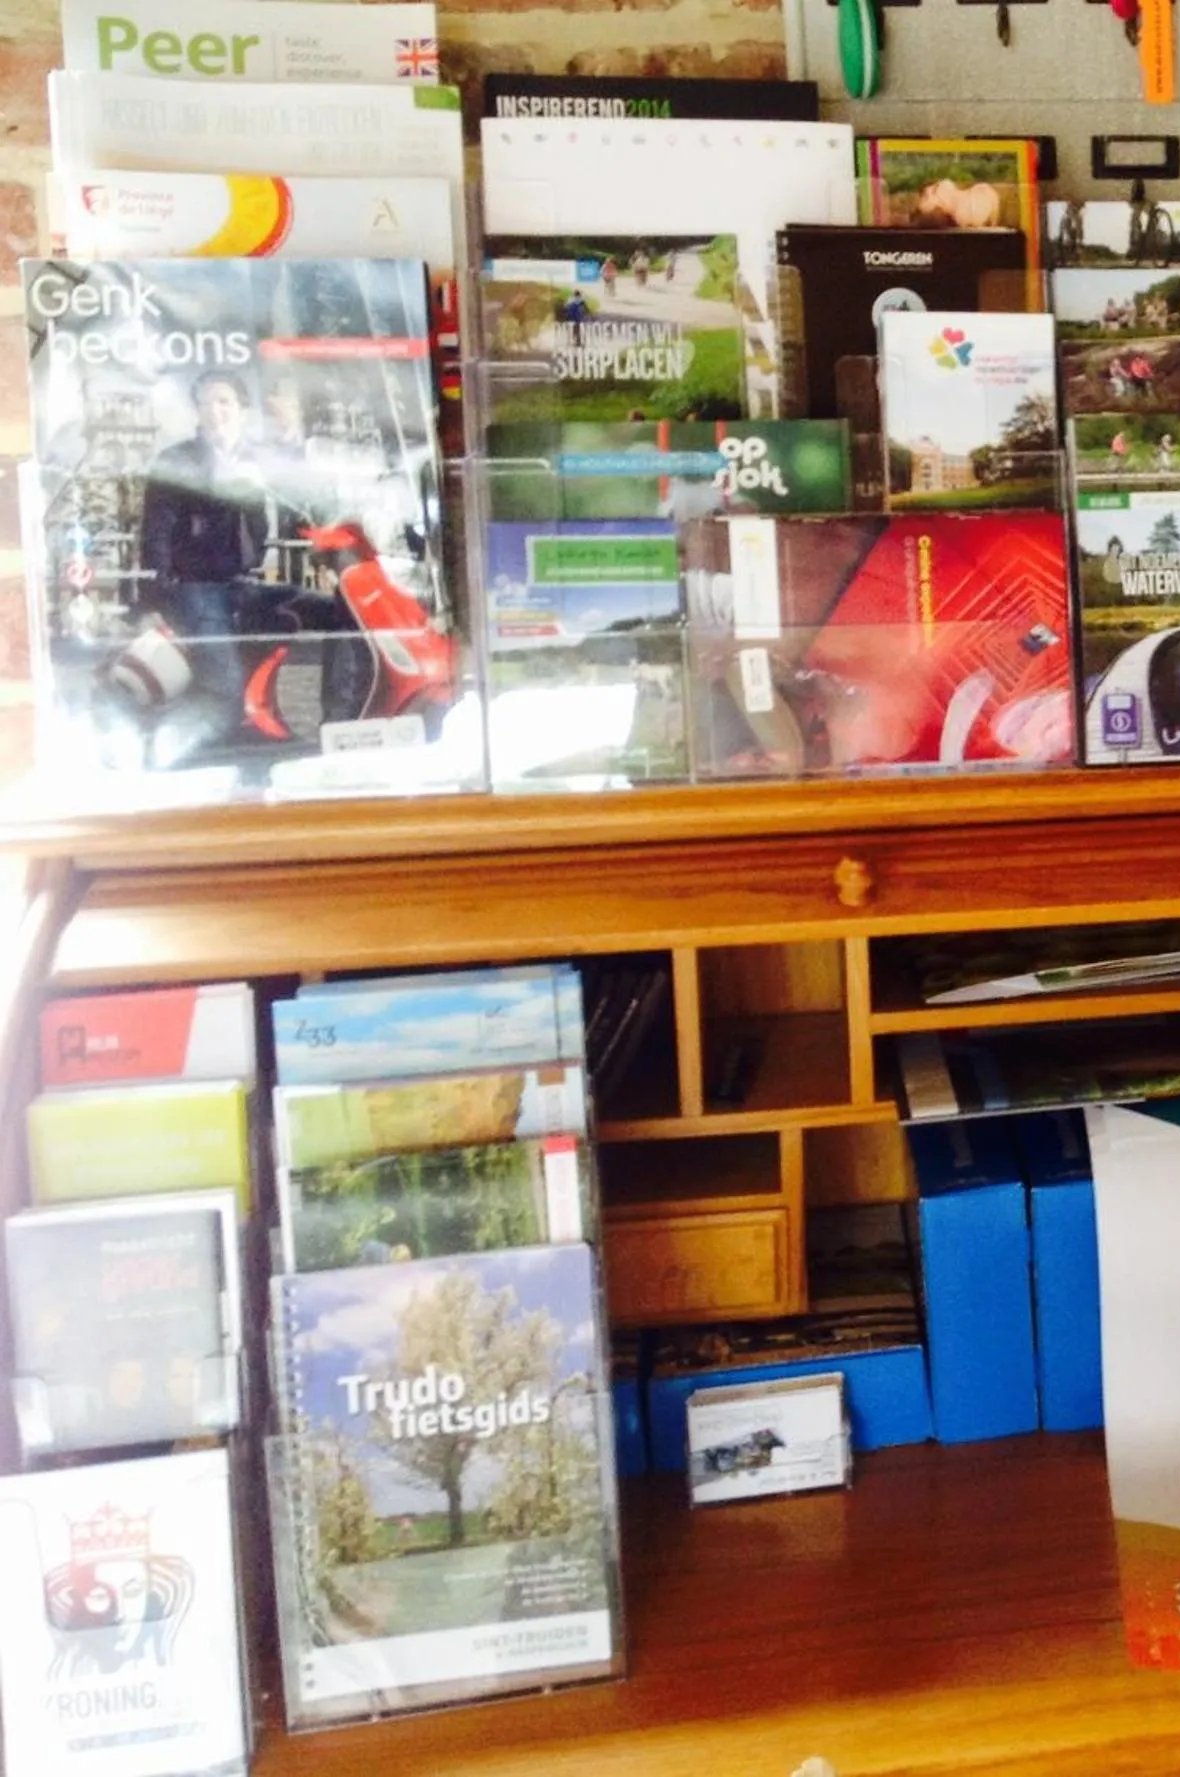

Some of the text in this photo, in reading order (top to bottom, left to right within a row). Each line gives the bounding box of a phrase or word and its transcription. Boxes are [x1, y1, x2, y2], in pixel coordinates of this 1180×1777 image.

[96, 17, 260, 75] Peer
[863, 251, 933, 265] TONGEREN
[31, 273, 161, 317] Genk
[47, 318, 251, 365] beckons
[554, 348, 683, 380] SURPLACEN
[719, 437, 767, 464] op
[712, 462, 788, 496] sjok
[337, 1365, 466, 1415] Trudo
[388, 1389, 551, 1439] fietsgids
